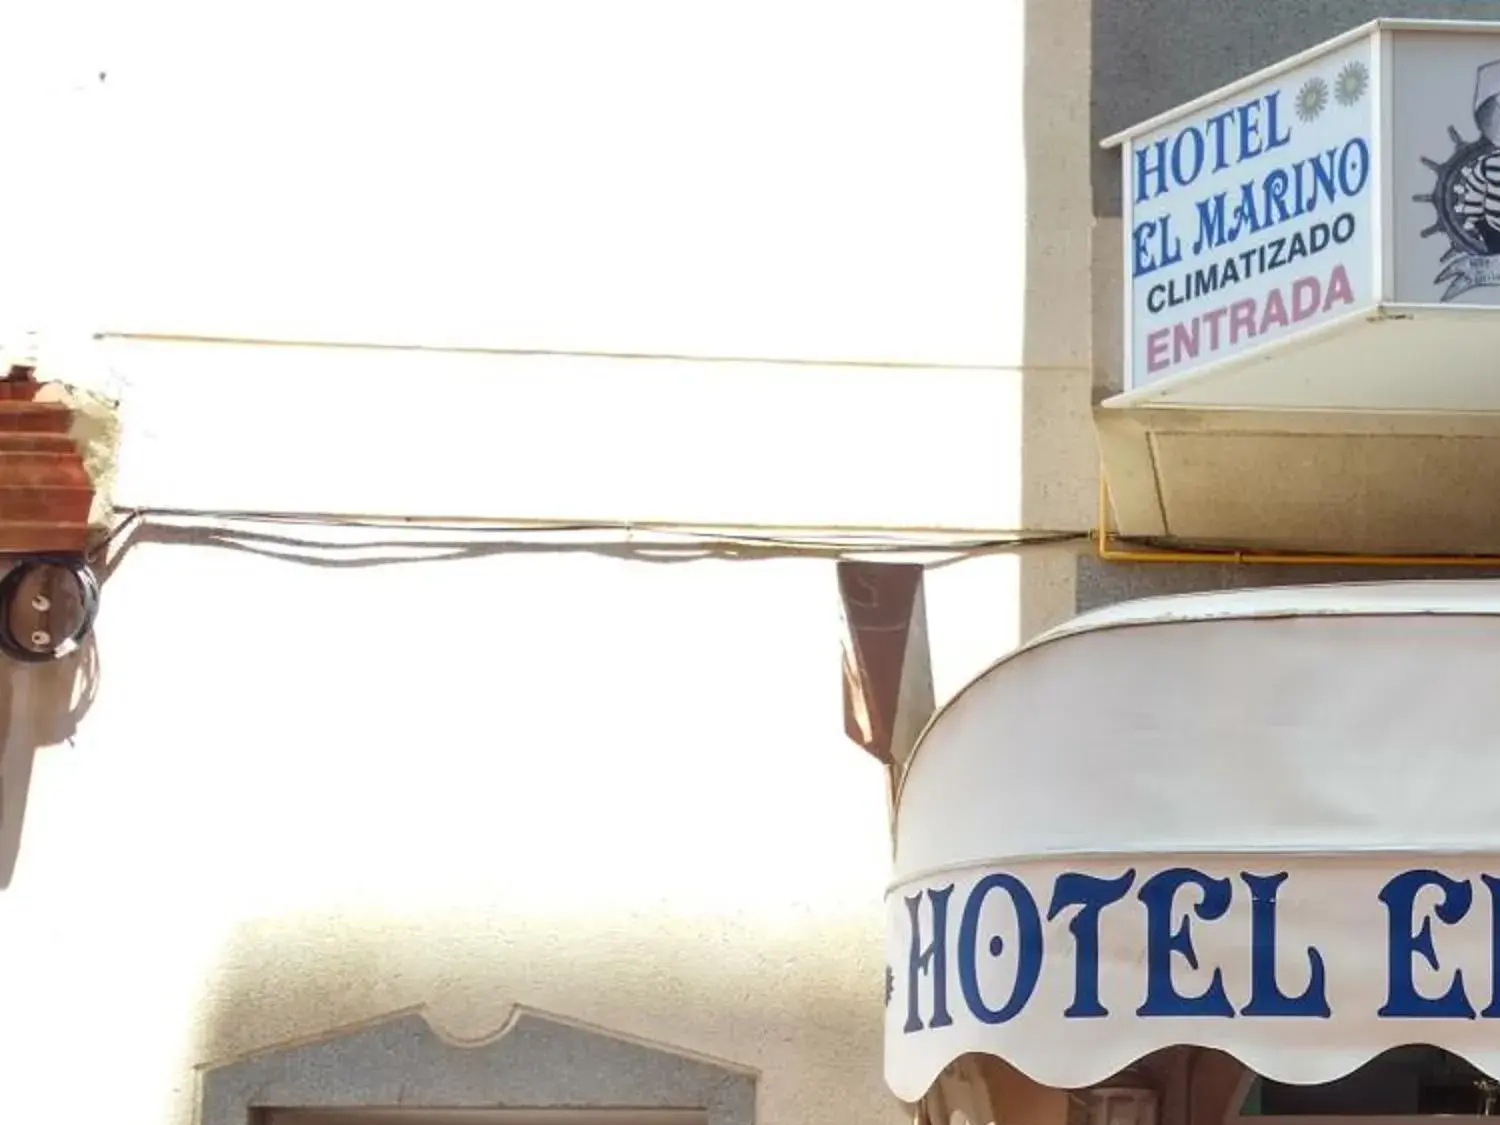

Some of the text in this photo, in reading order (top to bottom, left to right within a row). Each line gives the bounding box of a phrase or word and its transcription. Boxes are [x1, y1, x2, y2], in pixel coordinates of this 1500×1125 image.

[1135, 89, 1291, 204] HOTEL
[1132, 137, 1369, 279] EL MARINO
[1147, 212, 1356, 314] CLIMATIZADO
[1147, 264, 1355, 374] ENTRADA
[903, 868, 1330, 1034] HOTEL
